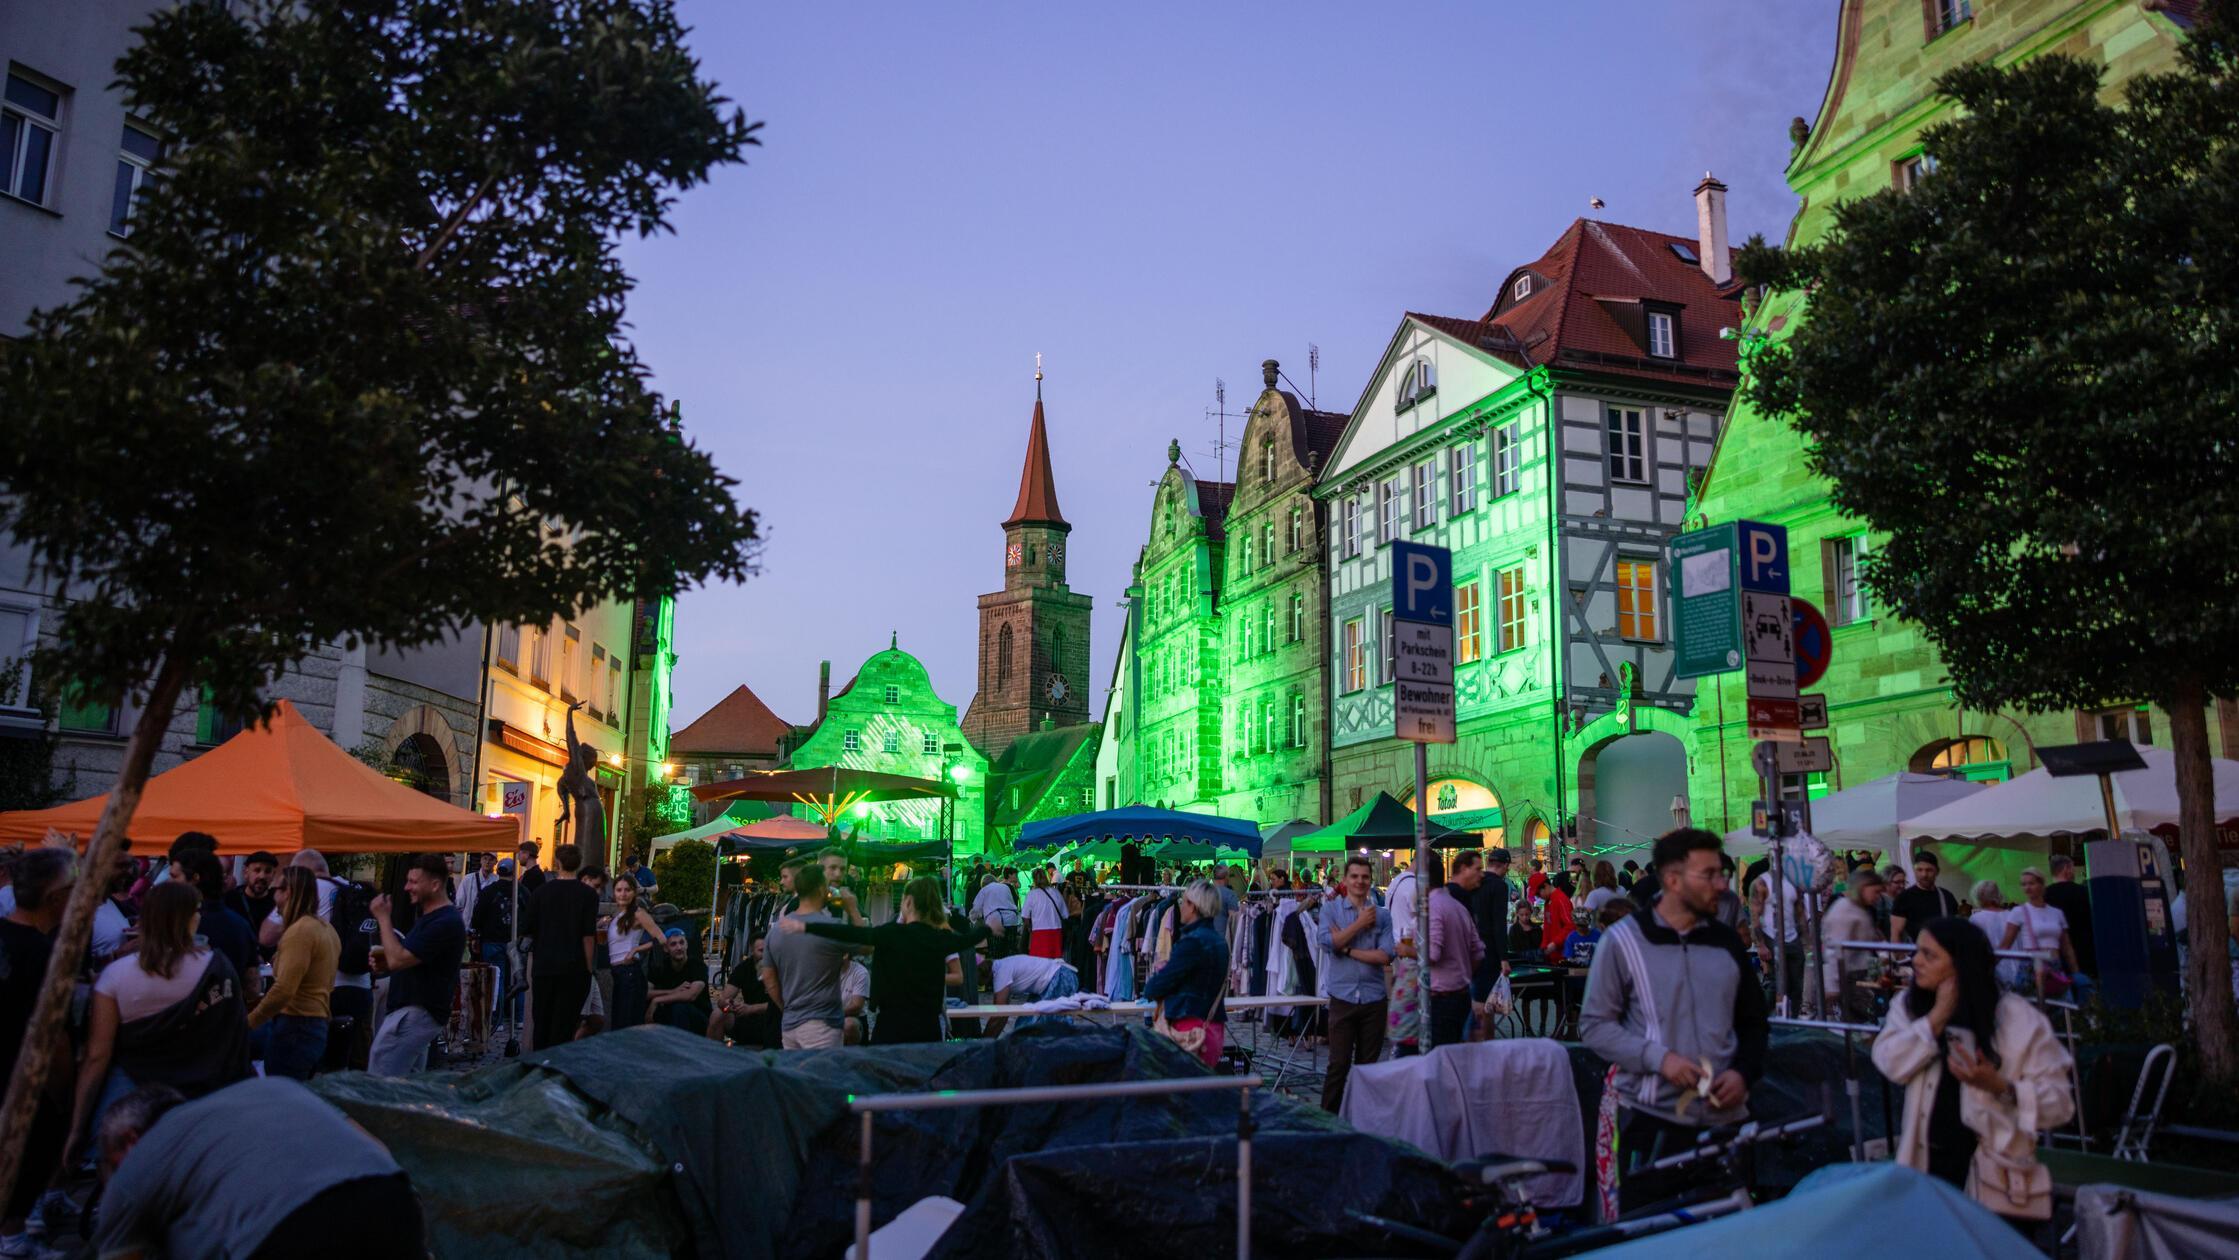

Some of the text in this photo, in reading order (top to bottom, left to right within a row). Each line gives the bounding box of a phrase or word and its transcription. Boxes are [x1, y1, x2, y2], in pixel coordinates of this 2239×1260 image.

[1750, 530, 1777, 581] P
[1407, 552, 1438, 611] P
[1416, 628, 1431, 641] mit
[1401, 640, 1447, 659] Parkschein
[1400, 684, 1451, 705] Bewohner
[1418, 716, 1436, 736] frei
[505, 788, 525, 809] Eis
[2140, 847, 2153, 875] P
